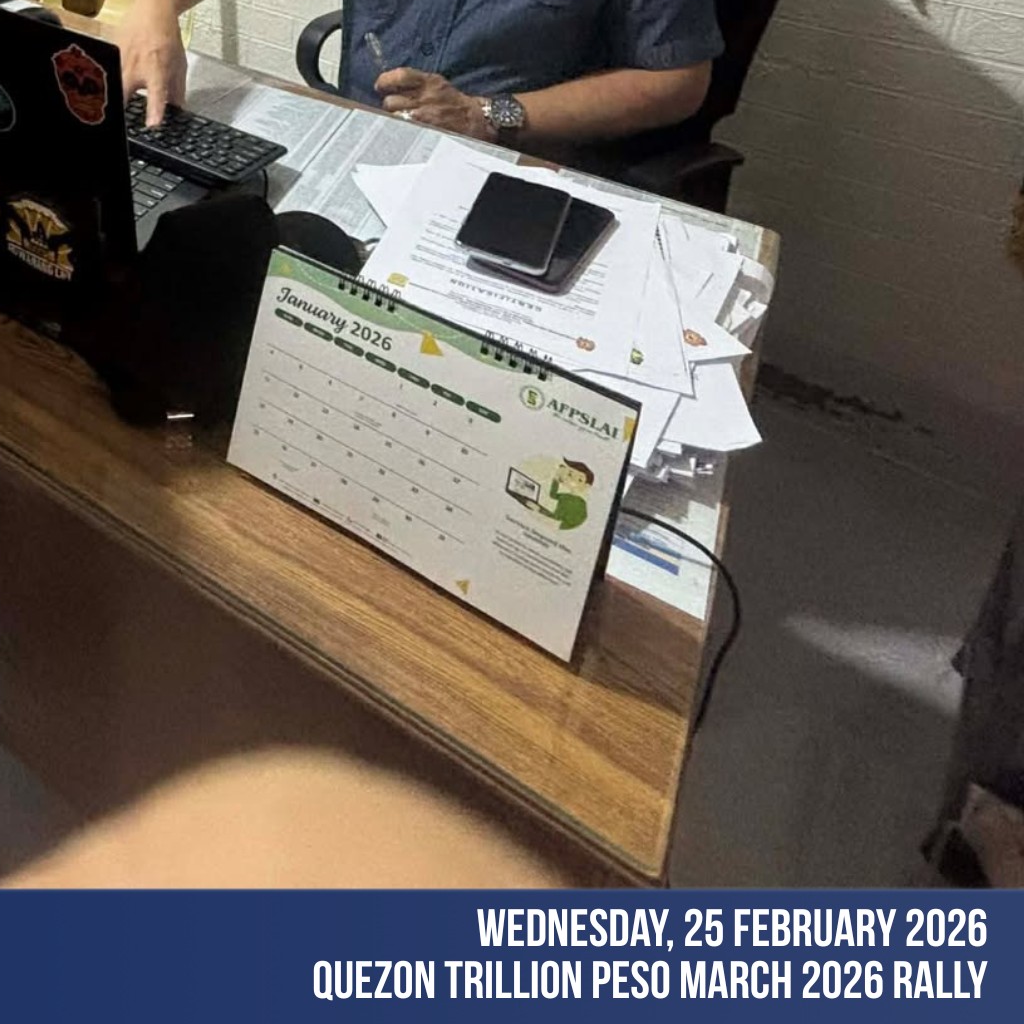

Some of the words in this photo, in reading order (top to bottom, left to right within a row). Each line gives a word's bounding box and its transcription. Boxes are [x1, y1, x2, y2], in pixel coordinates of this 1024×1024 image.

[276, 287, 349, 334] January
[350, 321, 393, 351] 2026
[547, 398, 619, 439] AFPSLAI
